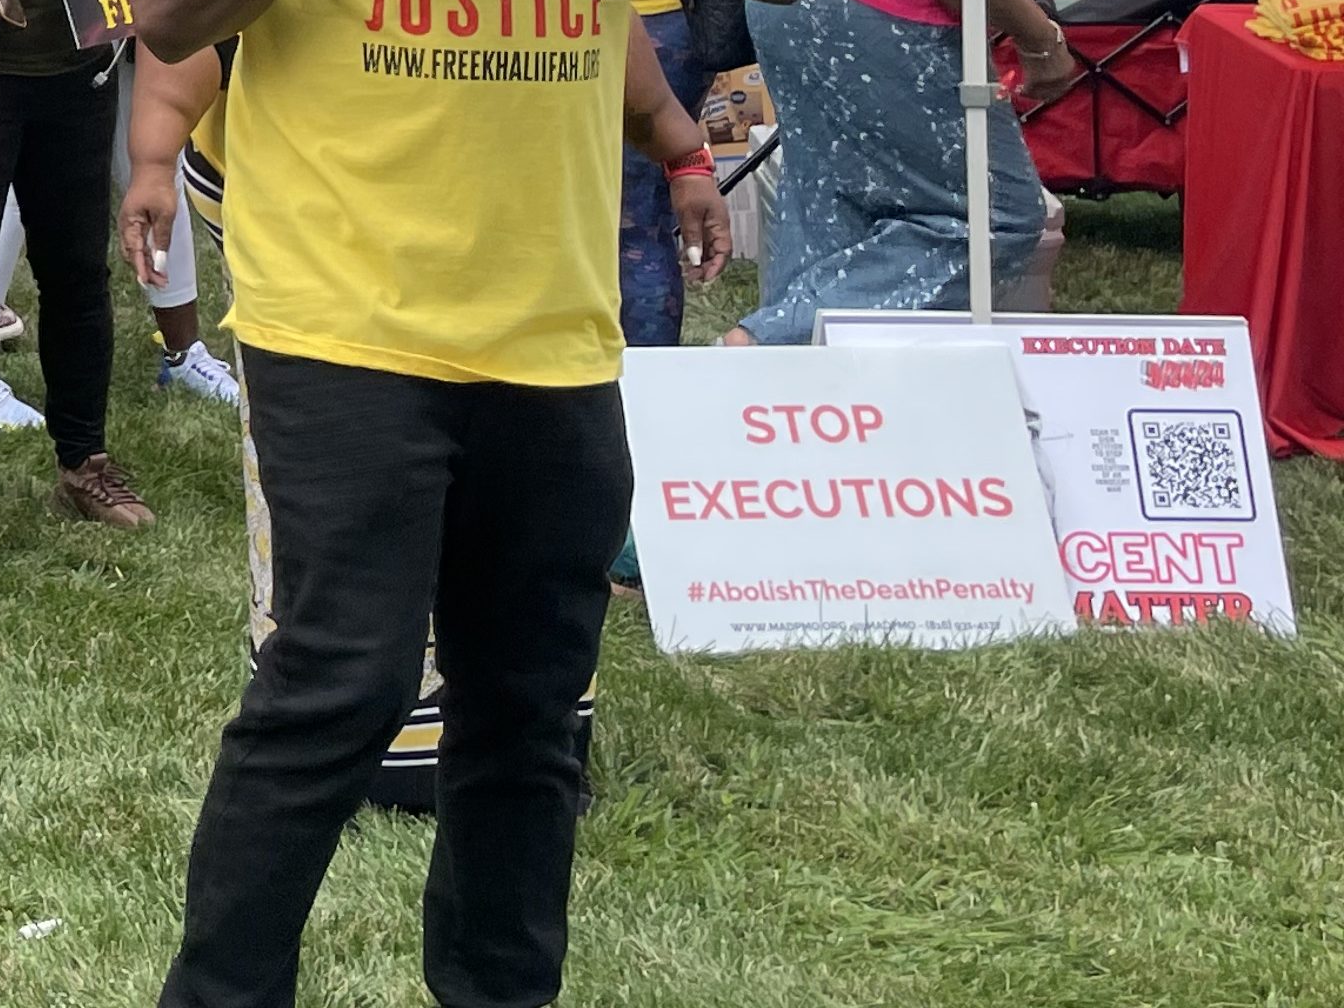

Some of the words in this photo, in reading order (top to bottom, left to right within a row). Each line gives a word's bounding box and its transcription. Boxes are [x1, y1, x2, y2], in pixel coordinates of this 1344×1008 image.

[1021, 337, 1157, 355] EXECUTION
[1163, 338, 1227, 356] DATE
[741, 403, 884, 446] STOP
[660, 477, 1014, 522] EXECUTIONS
[1061, 531, 1244, 584] CENT
[687, 577, 1035, 604] #AbolishTheDeathPenalty
